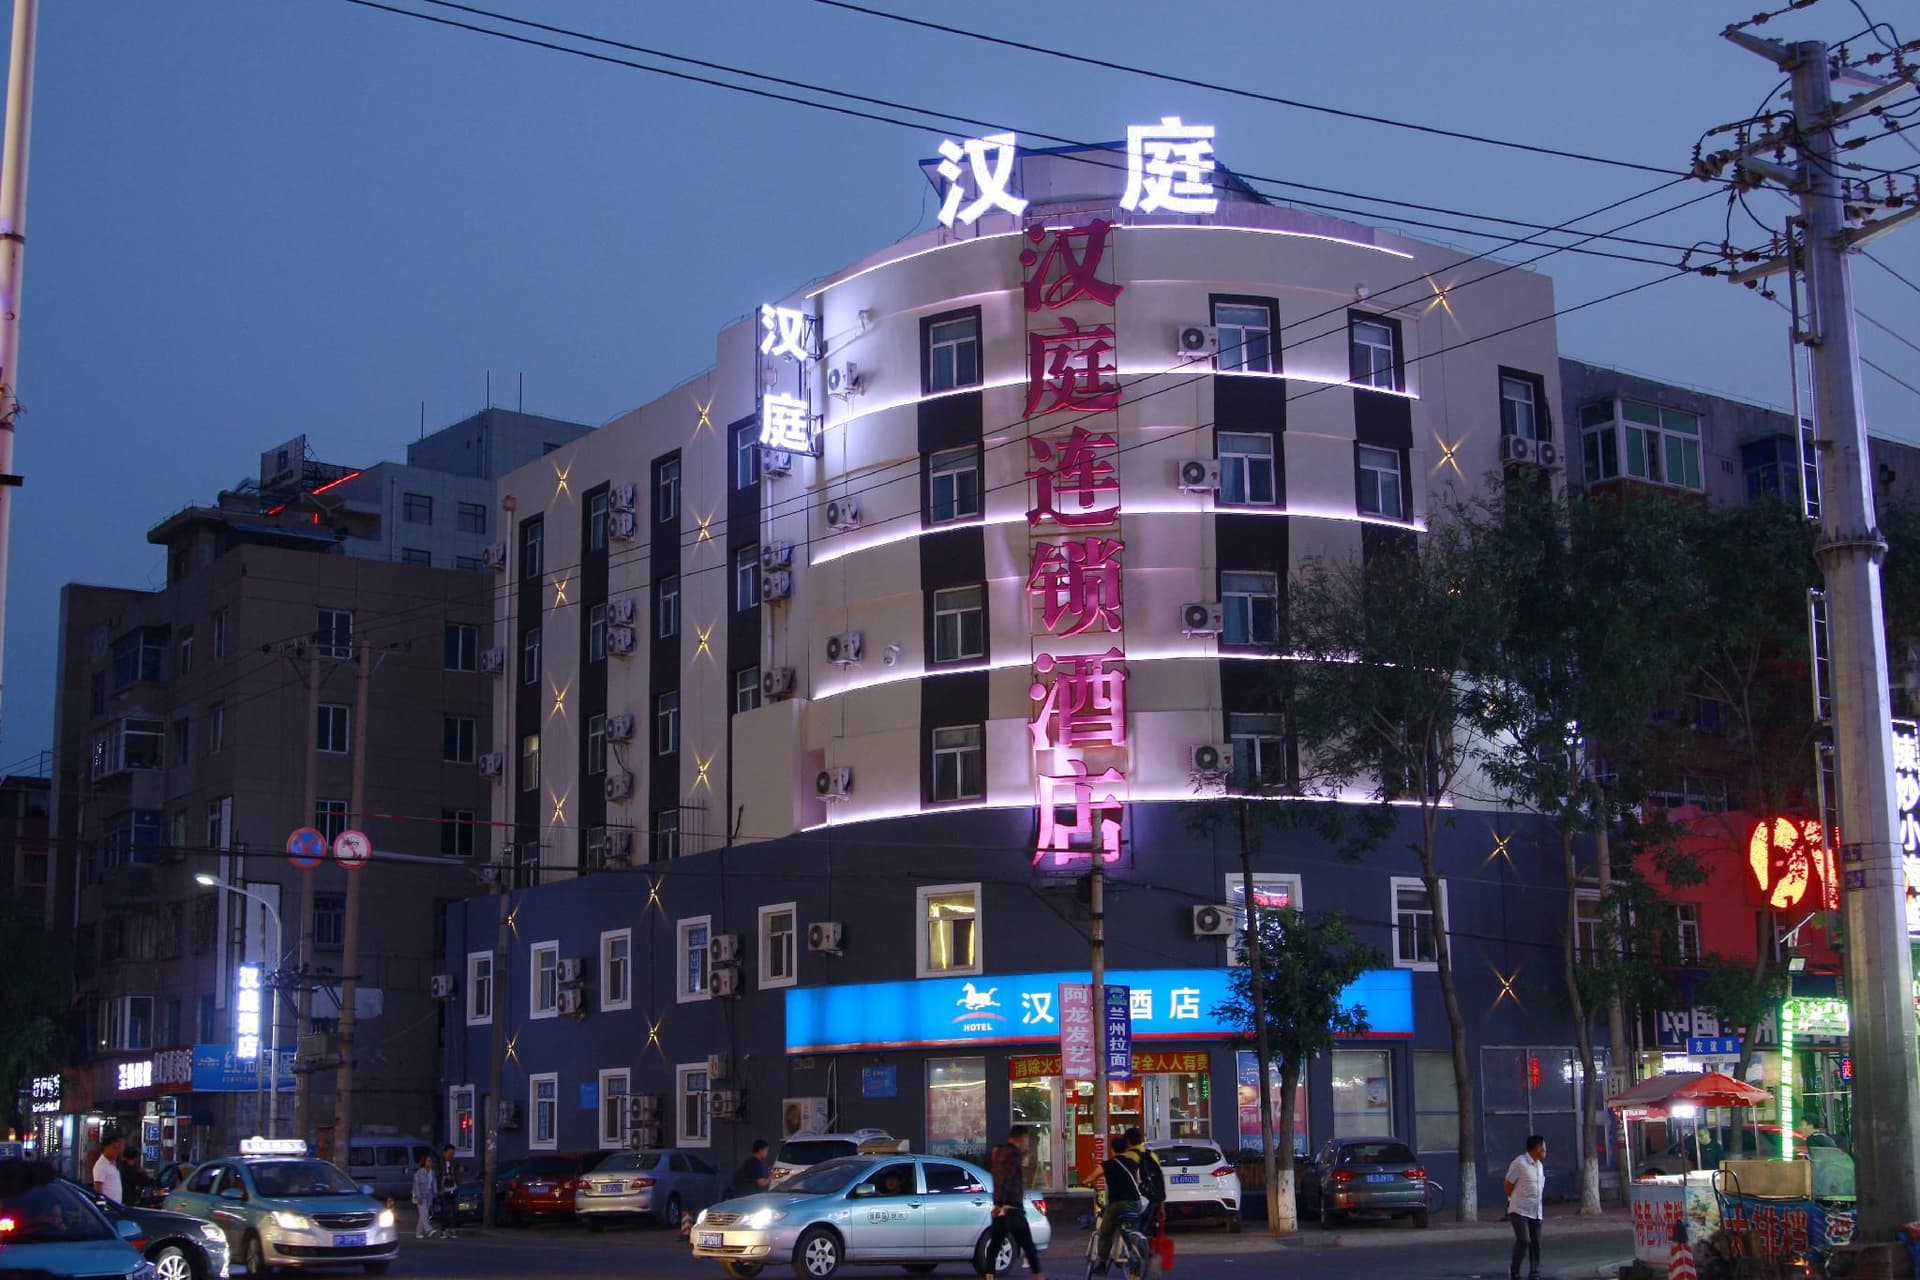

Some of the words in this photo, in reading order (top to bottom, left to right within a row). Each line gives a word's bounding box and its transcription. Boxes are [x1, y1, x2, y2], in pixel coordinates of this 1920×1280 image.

[936, 115, 1219, 228] 汉庭
[759, 302, 808, 452] 汉庭
[1018, 217, 1125, 867] 汉庭连锁酒店
[963, 1022, 993, 1032] HOTEL
[1063, 986, 1090, 1064] 阿龙发艺
[1108, 1006, 1128, 1068] 兰州拉面
